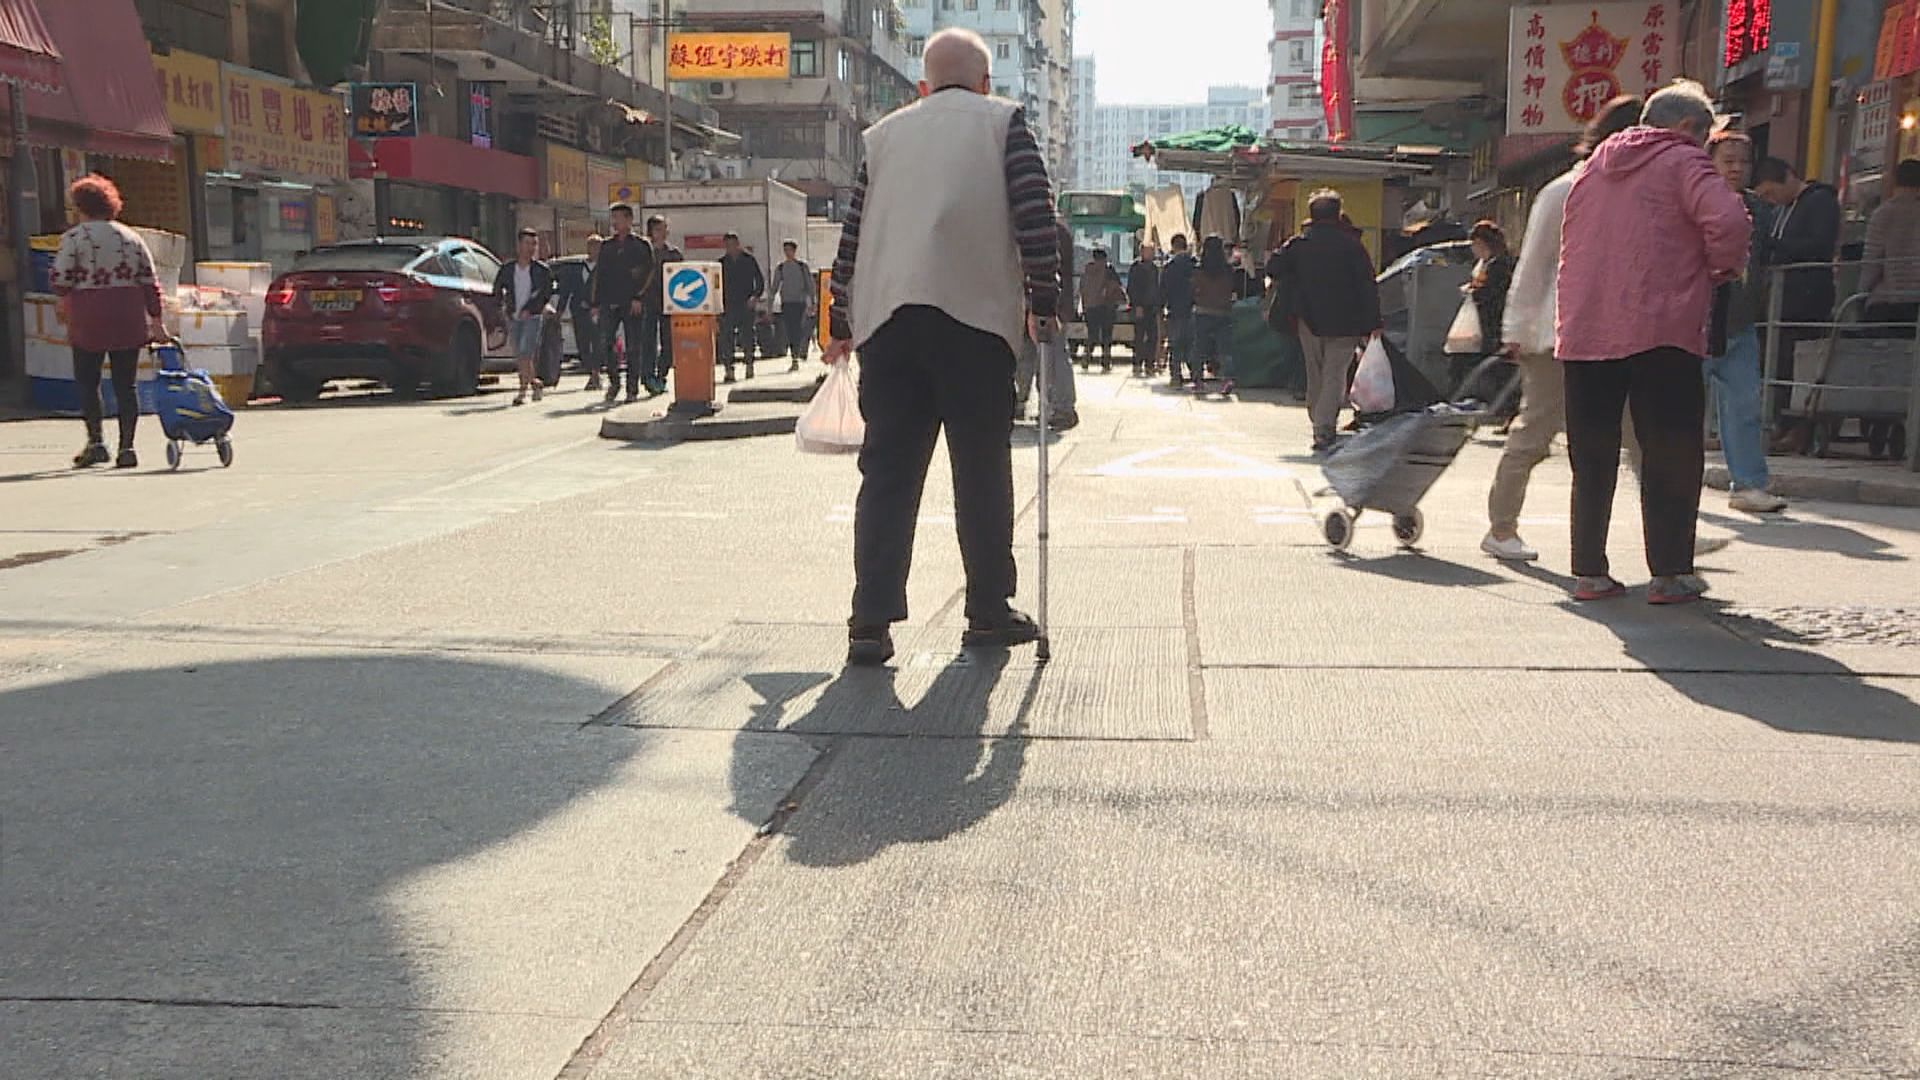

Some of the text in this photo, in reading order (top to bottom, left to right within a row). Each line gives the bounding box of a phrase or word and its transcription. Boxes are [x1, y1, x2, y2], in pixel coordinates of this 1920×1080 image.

[1520, 13, 1546, 127] 高價押物
[1571, 77, 1611, 115] 押
[1640, 3, 1665, 100] 原當貨
